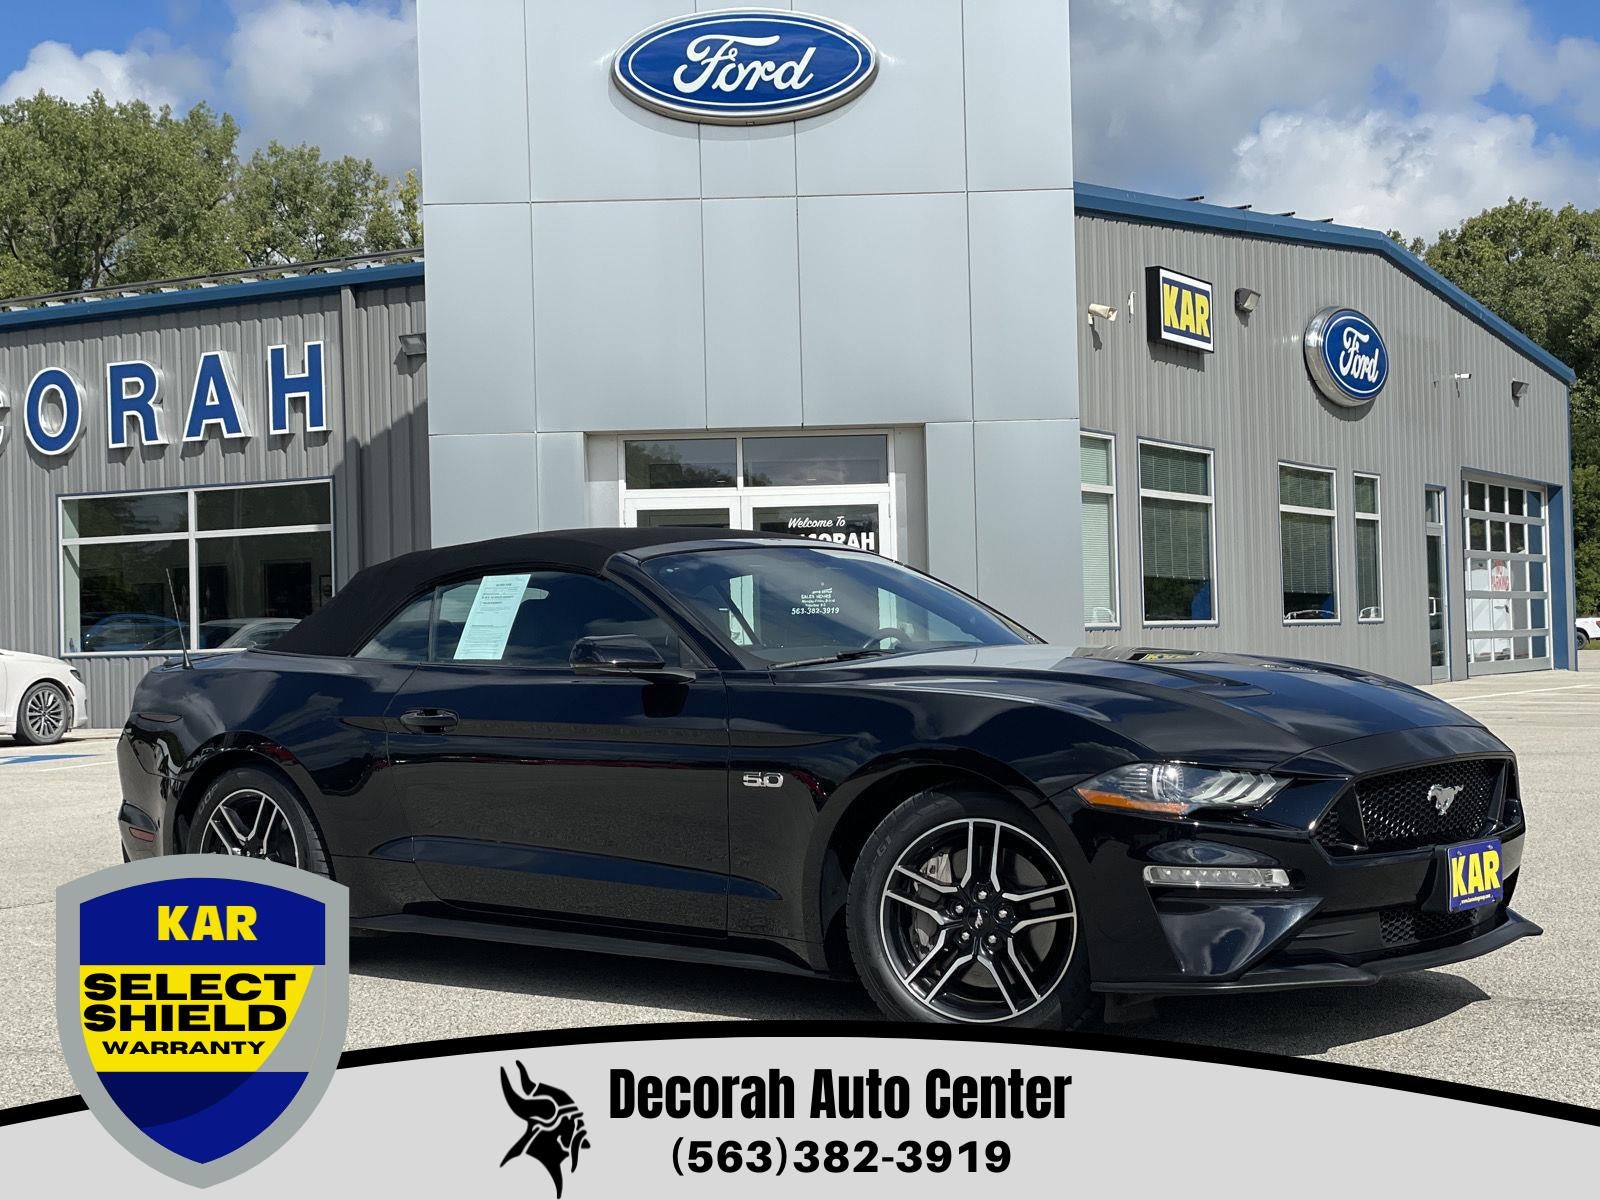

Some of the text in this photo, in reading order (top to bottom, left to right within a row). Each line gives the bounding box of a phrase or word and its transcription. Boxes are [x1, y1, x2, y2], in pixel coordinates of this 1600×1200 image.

[673, 34, 816, 93] Ford
[1163, 283, 1210, 338] KAR
[1339, 326, 1379, 383] Ford
[0, 340, 327, 455] ORAH
[788, 515, 846, 528] Welcome To
[800, 531, 875, 550] ORAH
[743, 771, 784, 788] 5.0
[1451, 850, 1501, 898] KAR
